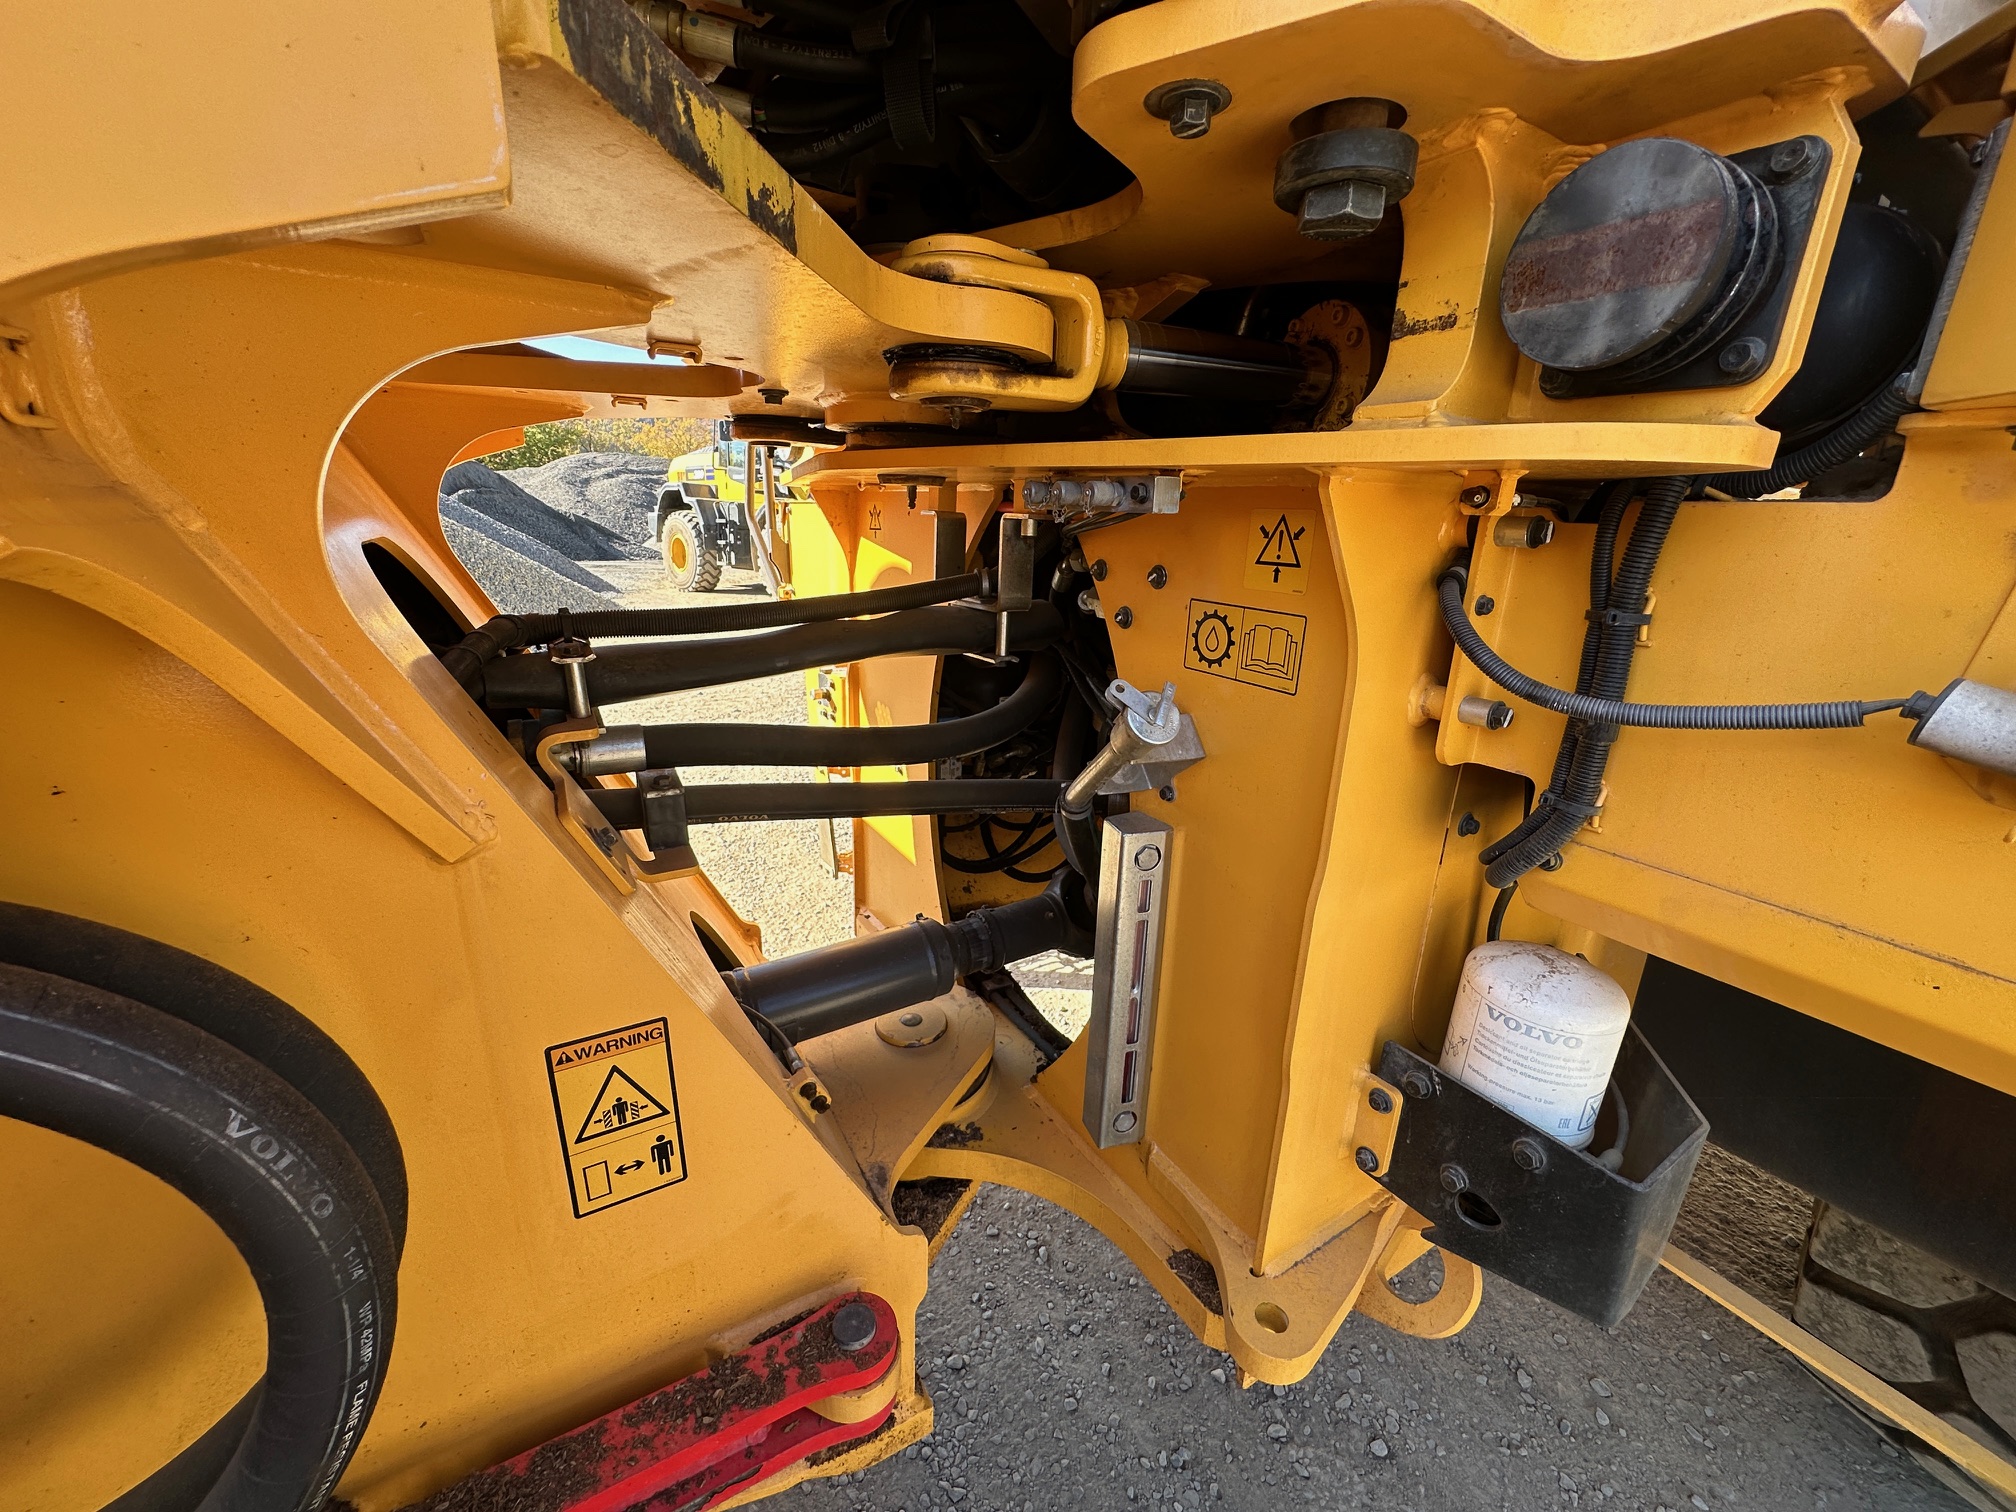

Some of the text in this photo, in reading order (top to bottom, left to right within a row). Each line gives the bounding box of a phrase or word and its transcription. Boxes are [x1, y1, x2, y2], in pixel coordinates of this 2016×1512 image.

[811, 135, 835, 153] DN12
[718, 814, 769, 822] VOLVO
[1485, 1002, 1583, 1049] VOLVO
[573, 1027, 663, 1061] WARNING
[1467, 1062, 1489, 1082] Working
[1488, 1078, 1516, 1095] pressure
[224, 1107, 334, 1219] VOLVO
[344, 1379, 369, 1432] FLAME
